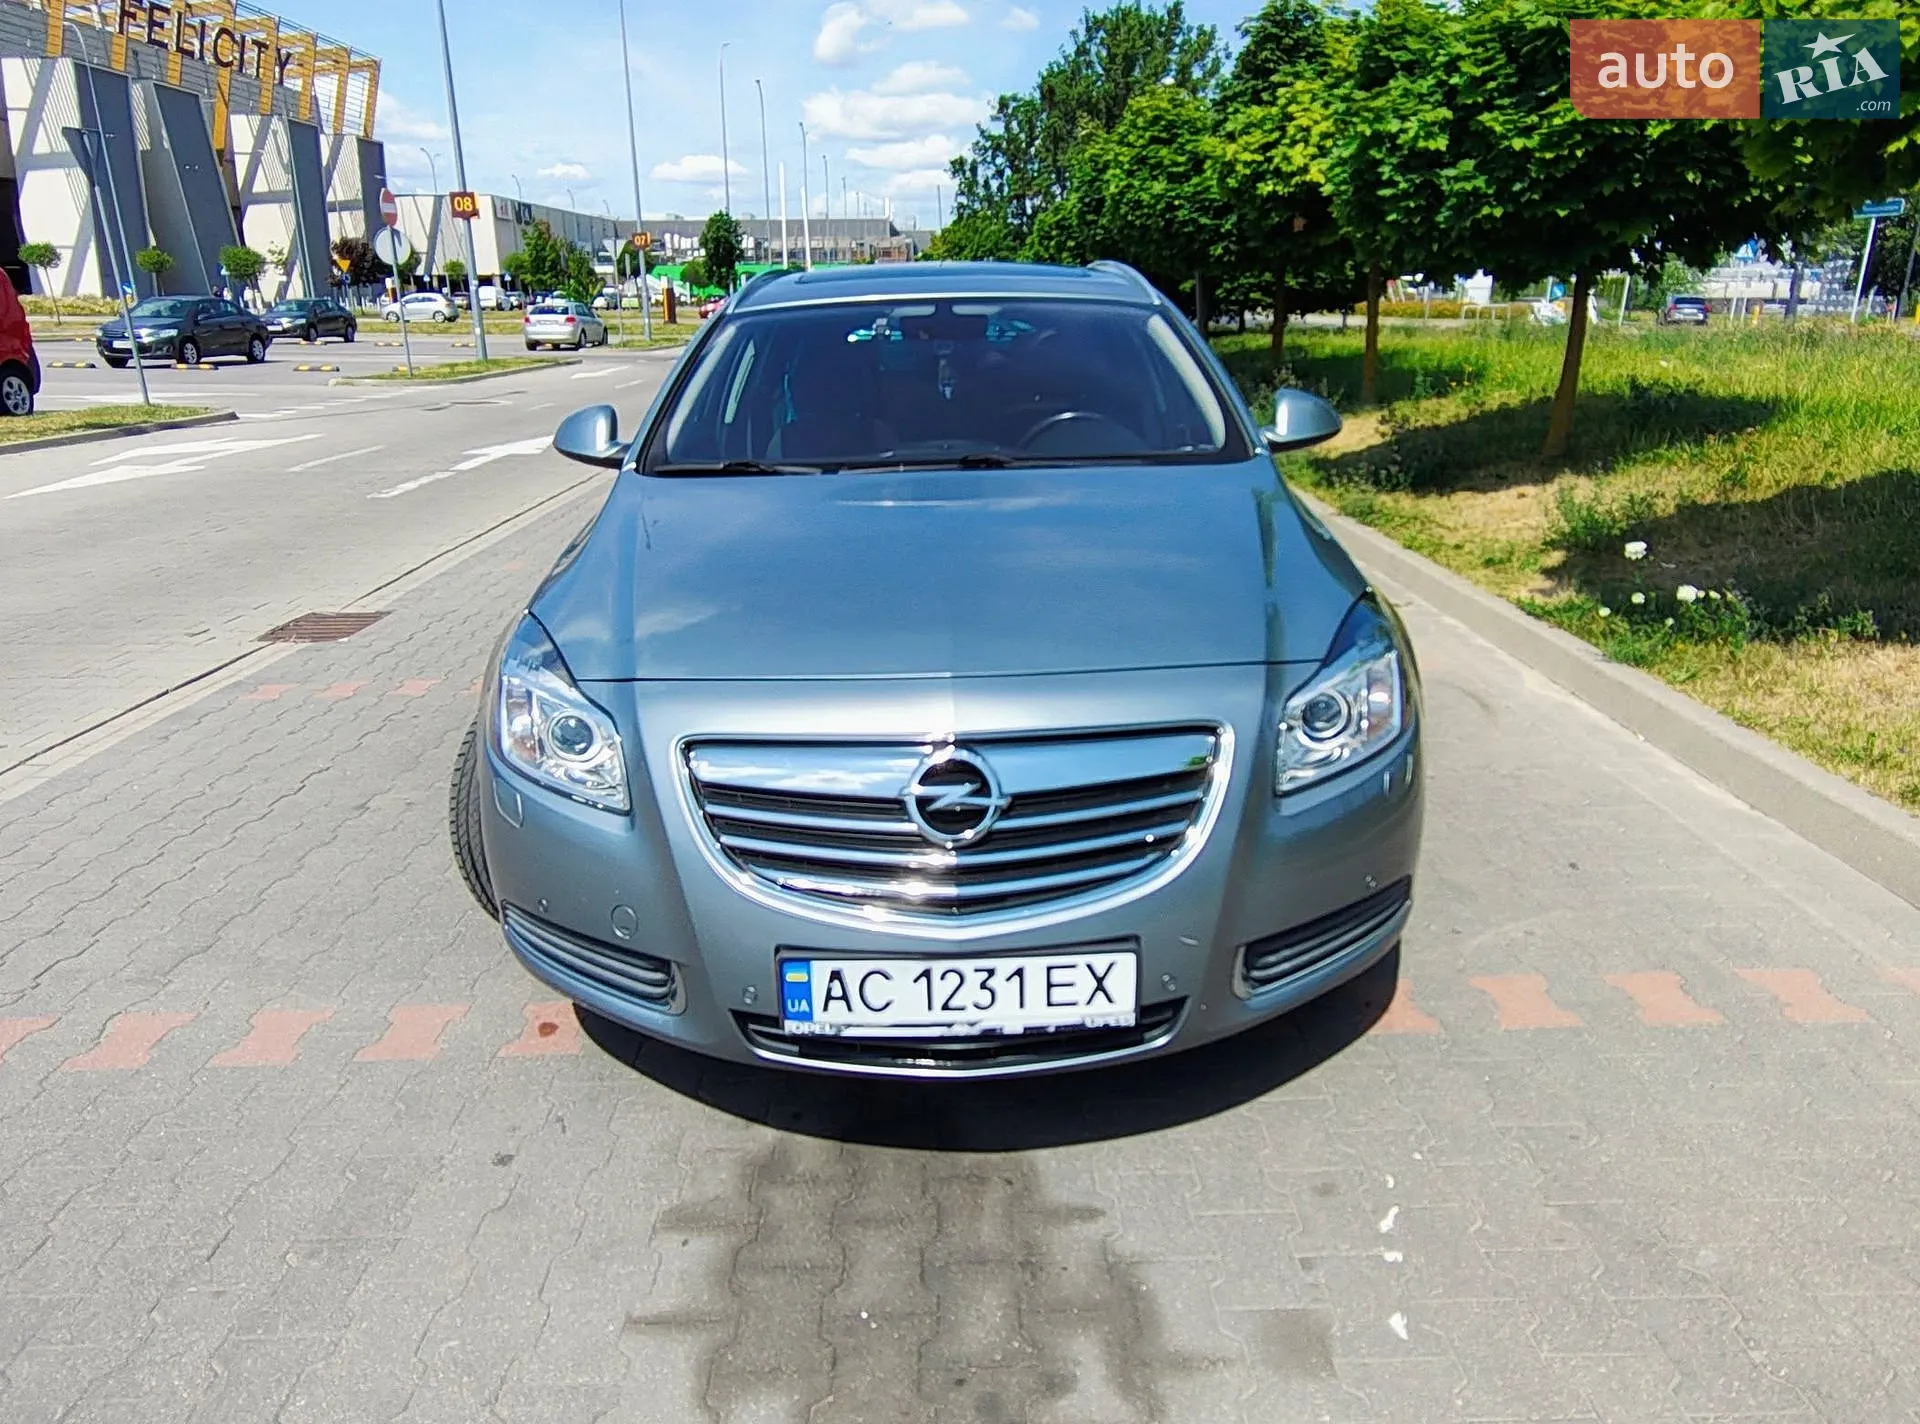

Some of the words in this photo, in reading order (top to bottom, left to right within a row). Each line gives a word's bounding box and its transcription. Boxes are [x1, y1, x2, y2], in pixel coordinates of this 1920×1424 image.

[118, 0, 292, 87] FELICITY
[453, 196, 474, 212] 08
[634, 235, 646, 246] 07
[822, 968, 895, 1013] AC
[912, 967, 1025, 1011] 1231
[1046, 961, 1116, 1007] EX
[787, 998, 810, 1013] UA
